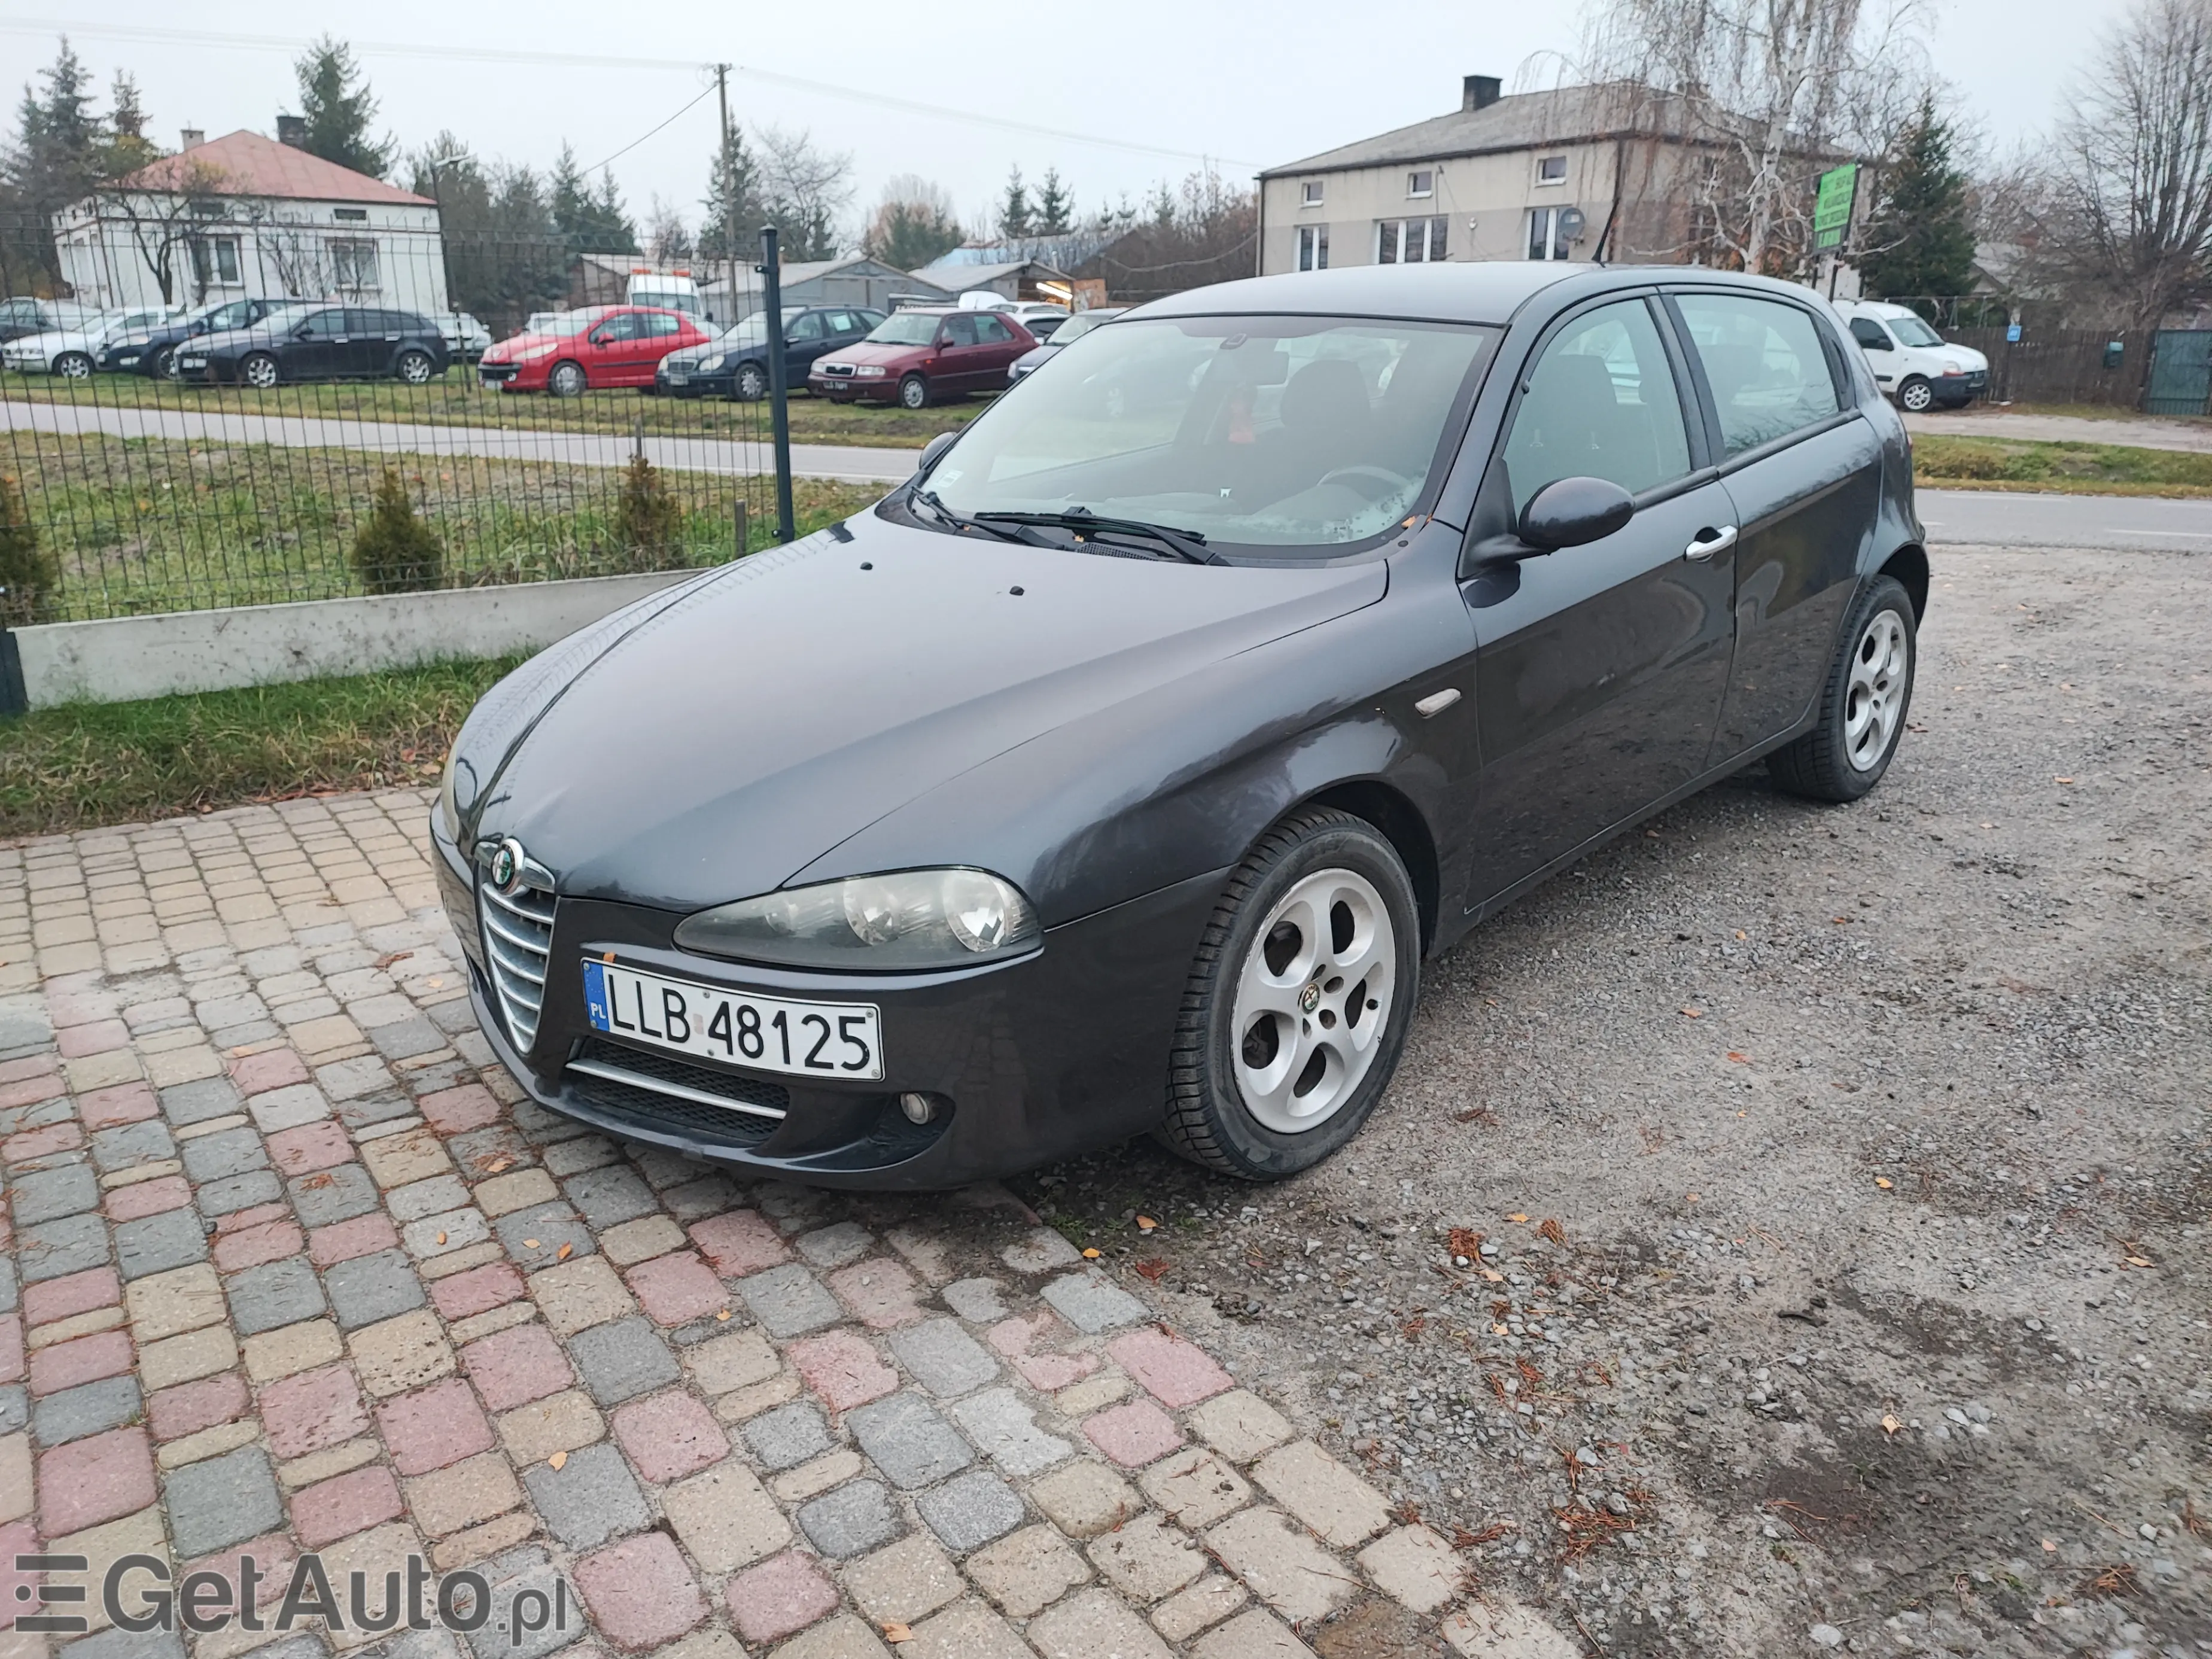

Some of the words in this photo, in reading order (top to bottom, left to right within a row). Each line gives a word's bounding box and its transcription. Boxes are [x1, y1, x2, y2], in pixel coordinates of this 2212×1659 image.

[590, 1002, 607, 1019] PL
[607, 973, 690, 1043] LLB
[708, 1000, 870, 1071] 48125
